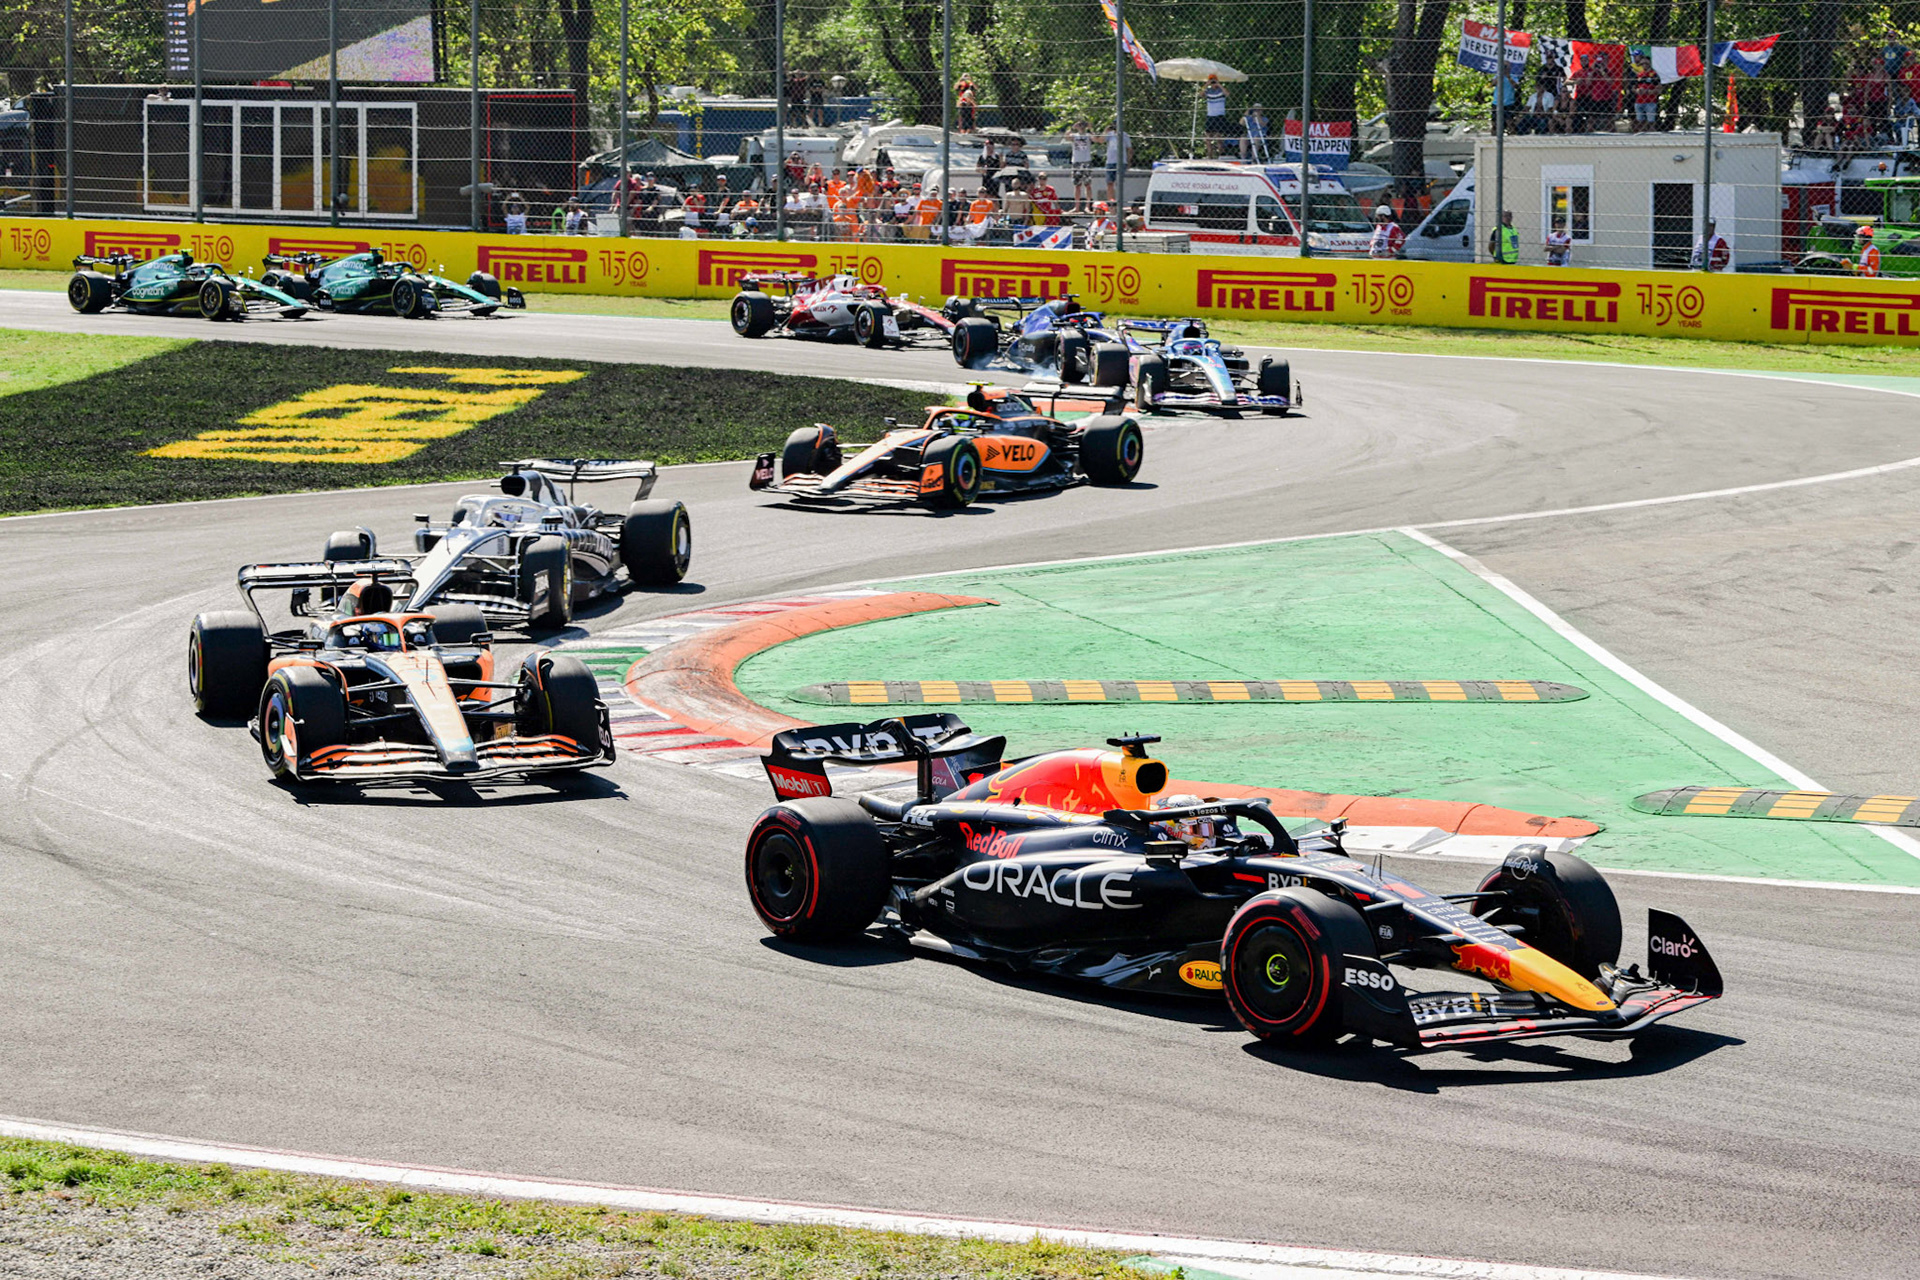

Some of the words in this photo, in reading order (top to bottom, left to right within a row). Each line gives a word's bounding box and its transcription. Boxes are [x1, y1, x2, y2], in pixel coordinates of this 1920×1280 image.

[10, 227, 51, 261] 150
[477, 246, 588, 284] PIRELLI
[599, 250, 649, 286] 150
[941, 259, 1070, 300] PIRELLI
[1084, 264, 1141, 304] 150
[1118, 297, 1140, 306] YEARS
[1197, 269, 1337, 312] PIRELLI
[1352, 274, 1414, 315] 150
[1469, 276, 1621, 323] PIRELLI
[1389, 307, 1413, 316] YEARS
[1636, 283, 1705, 327] 150
[1770, 288, 1920, 336] PIRELL
[1677, 319, 1702, 329] YEARS
[1001, 444, 1035, 461] VELO
[771, 772, 812, 794] Mobil
[1197, 807, 1219, 816] Tezos
[963, 861, 1144, 910] ORACLE
[1650, 934, 1692, 958] Claro
[1194, 968, 1222, 982] RAUC
[1344, 967, 1395, 992] ESSO
